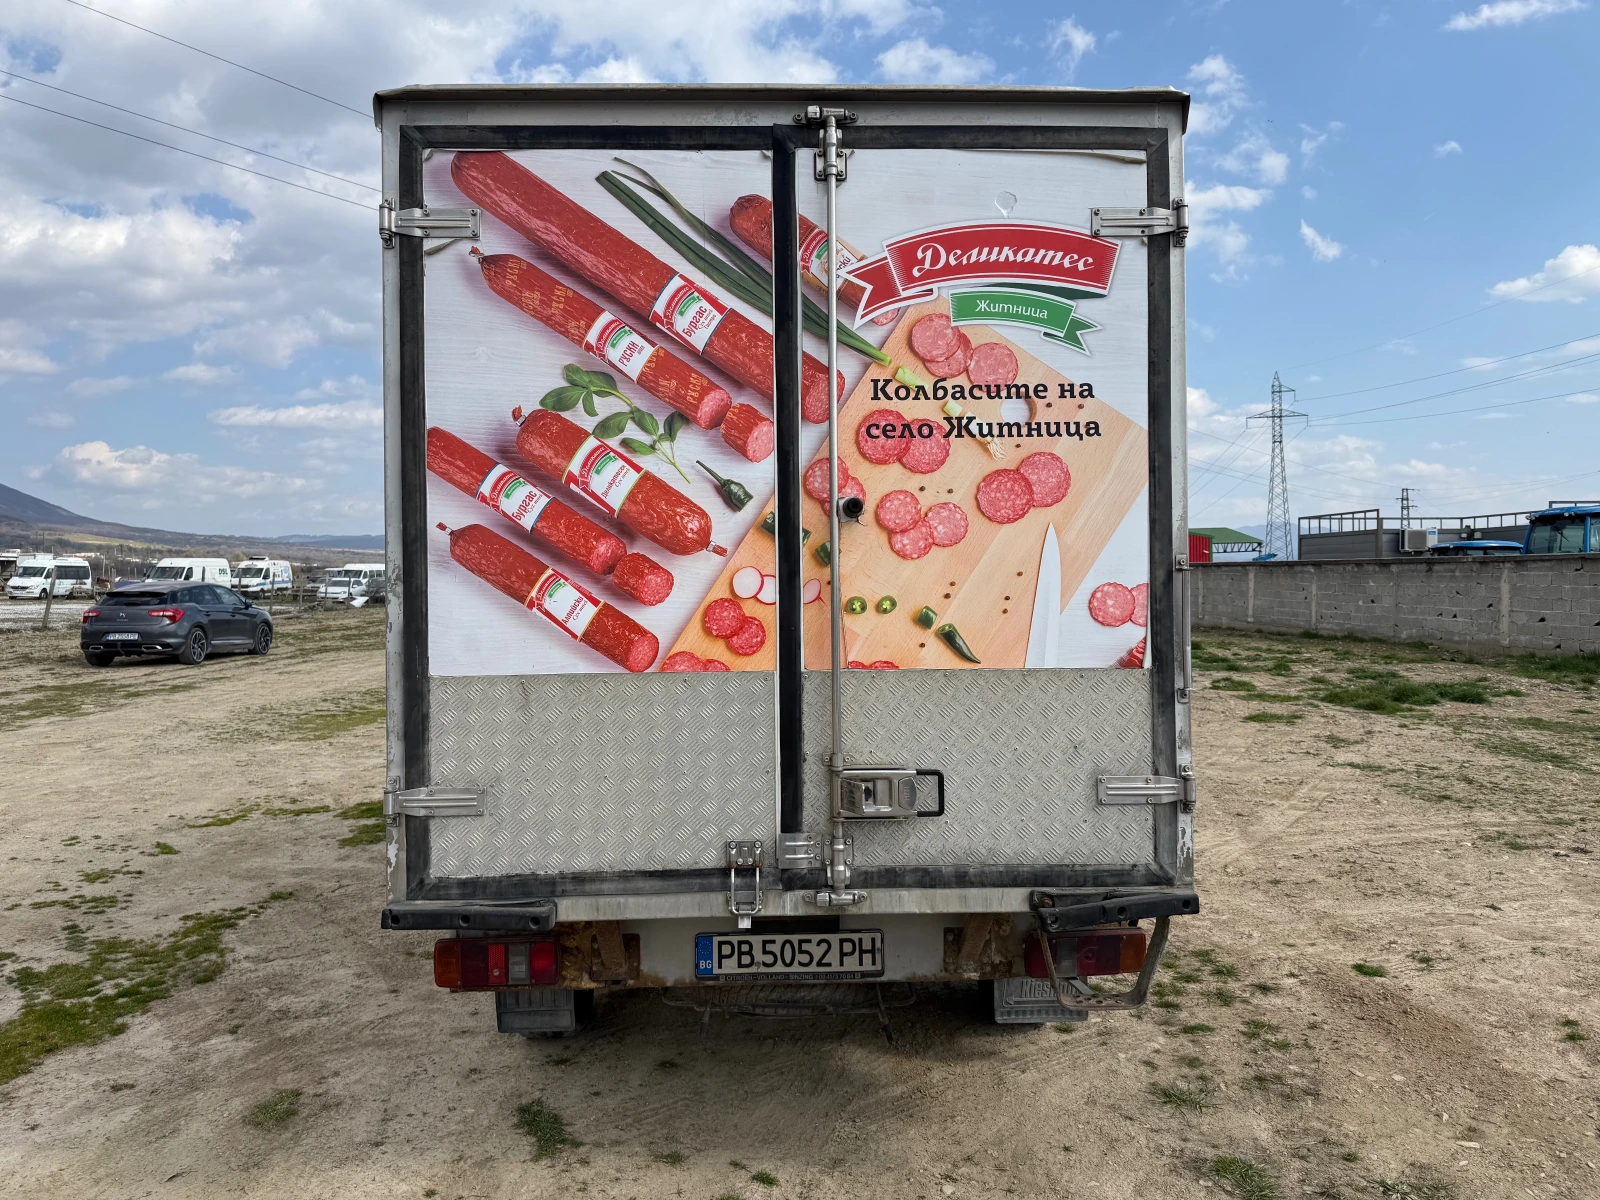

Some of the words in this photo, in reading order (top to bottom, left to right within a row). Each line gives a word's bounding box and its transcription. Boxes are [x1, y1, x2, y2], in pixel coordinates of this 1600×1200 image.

[912, 243, 1095, 278] Деликатес
[682, 305, 708, 337] Бургас
[975, 299, 1048, 319] Житница
[870, 378, 1048, 401] Колбасите
[1058, 382, 1095, 400] на
[865, 421, 934, 439] село
[943, 415, 1101, 441] Житница
[512, 490, 537, 520] Бургас
[700, 960, 712, 969] BG
[717, 940, 755, 969] PB
[762, 938, 832, 968] 5052
[839, 937, 876, 967] PH
